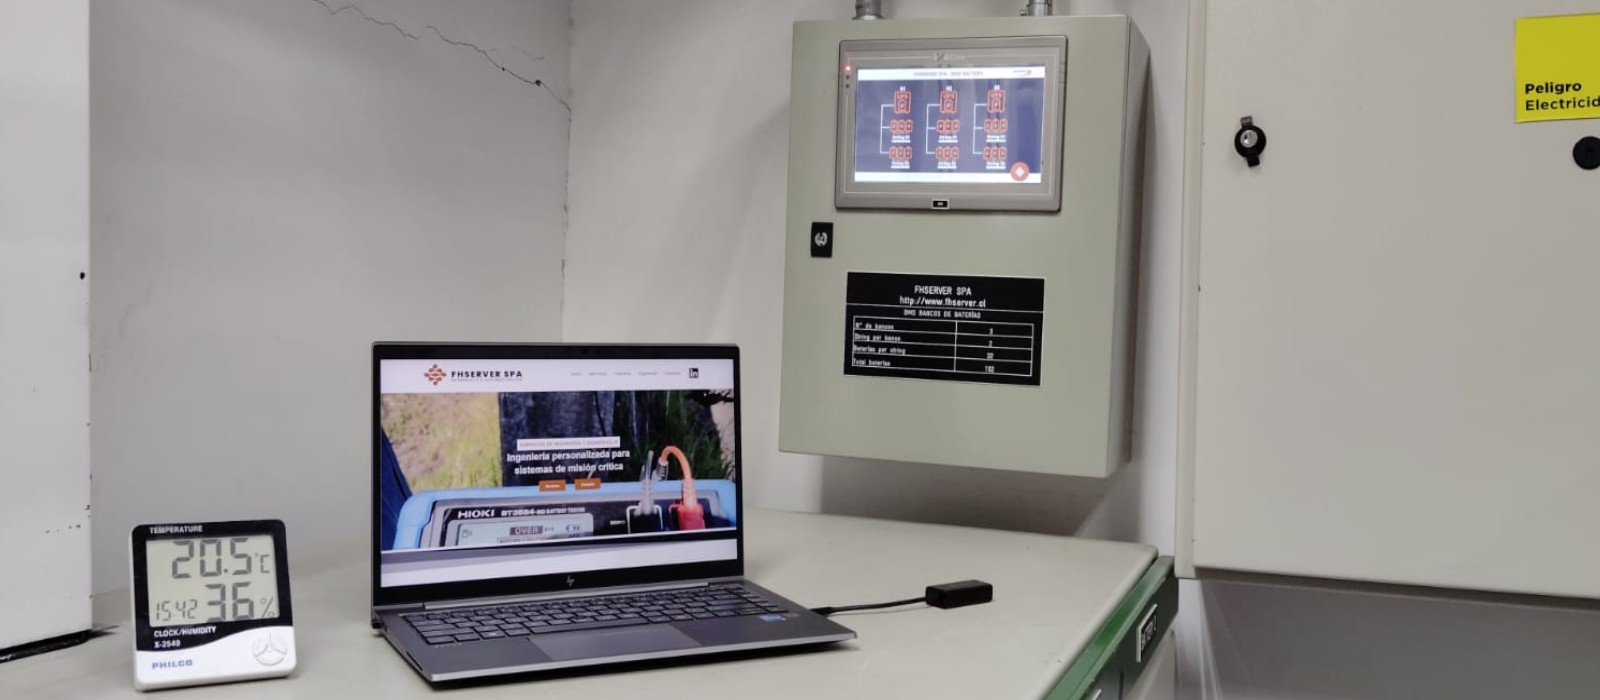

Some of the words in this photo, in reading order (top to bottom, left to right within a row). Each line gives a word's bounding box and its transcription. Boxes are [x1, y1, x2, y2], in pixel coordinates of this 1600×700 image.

[1525, 81, 1582, 95] Peligro
[914, 284, 953, 295] FHSERVER
[956, 286, 972, 296] SPA
[899, 295, 986, 308] http://www.fhserver.cl
[451, 370, 501, 378] FHSERVER
[503, 370, 523, 378] SPA
[551, 450, 610, 461] personalizada
[611, 450, 631, 459] para
[514, 465, 554, 475] sistemas
[555, 464, 566, 473] de
[567, 463, 596, 472] misión
[457, 508, 495, 519] HIOKI
[150, 525, 203, 534] TEMPERATURE
[514, 526, 540, 535] OVER
[172, 537, 252, 579] 20.5
[205, 582, 254, 623] 36
[153, 625, 217, 638] CLOCK/HUMIDITY
[152, 659, 193, 669] PHILCO
